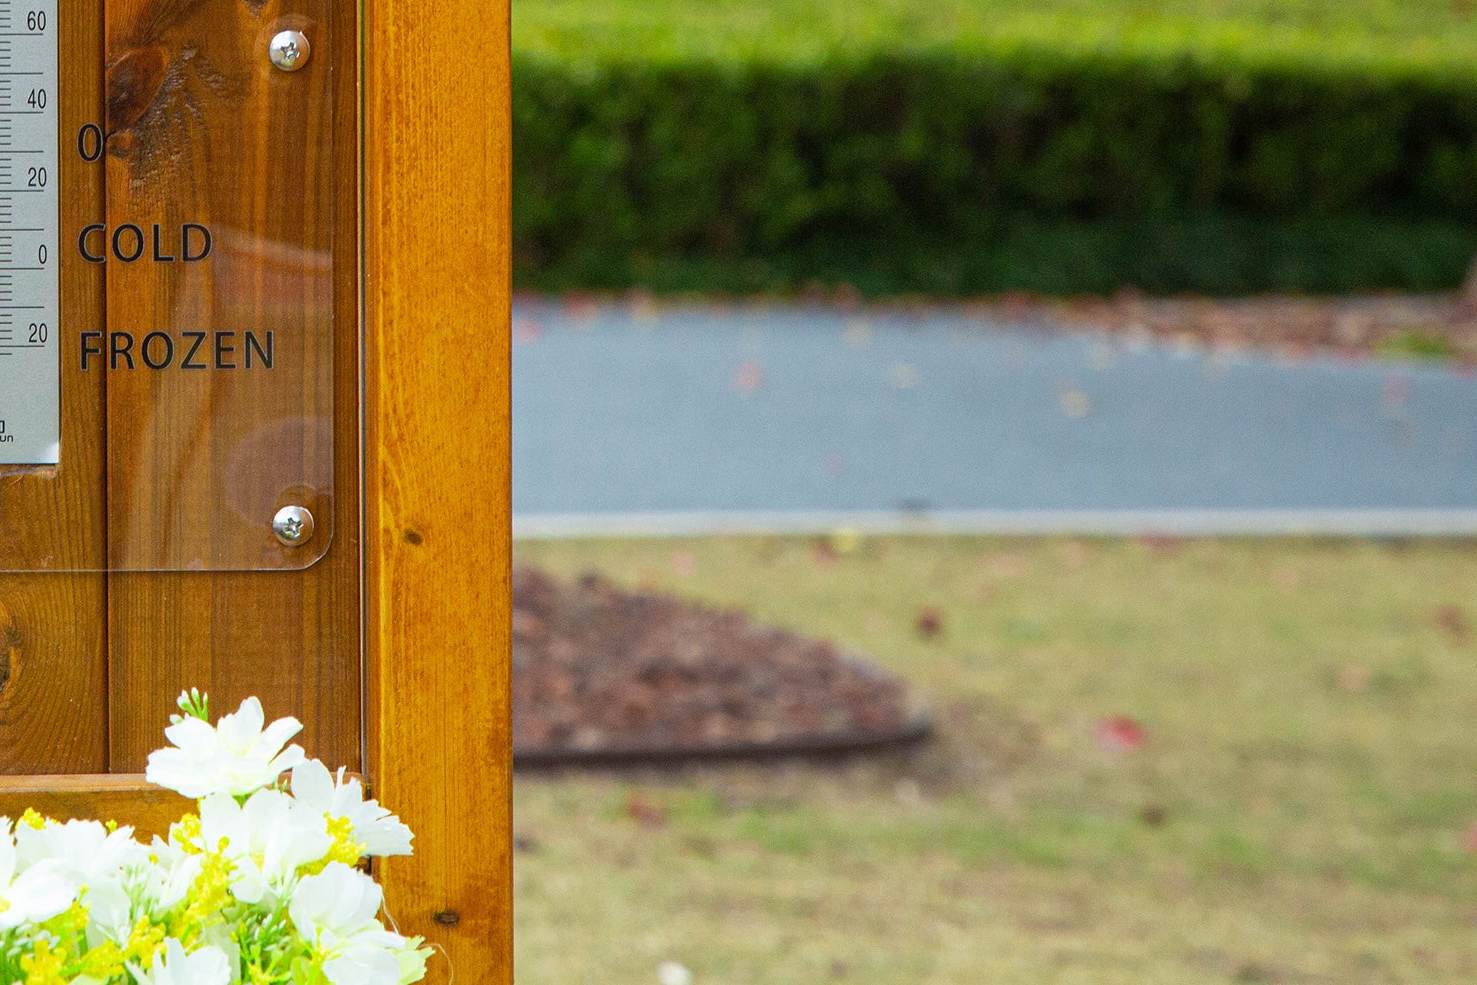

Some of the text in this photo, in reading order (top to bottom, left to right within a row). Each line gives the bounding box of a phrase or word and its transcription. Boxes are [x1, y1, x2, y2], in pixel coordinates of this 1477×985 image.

[27, 10, 47, 31] 60
[27, 88, 47, 109] 40
[27, 167, 47, 188] 20
[76, 222, 213, 264] COLD
[38, 244, 48, 265] 0
[28, 322, 48, 344] 20
[79, 330, 275, 371] FROZEN
